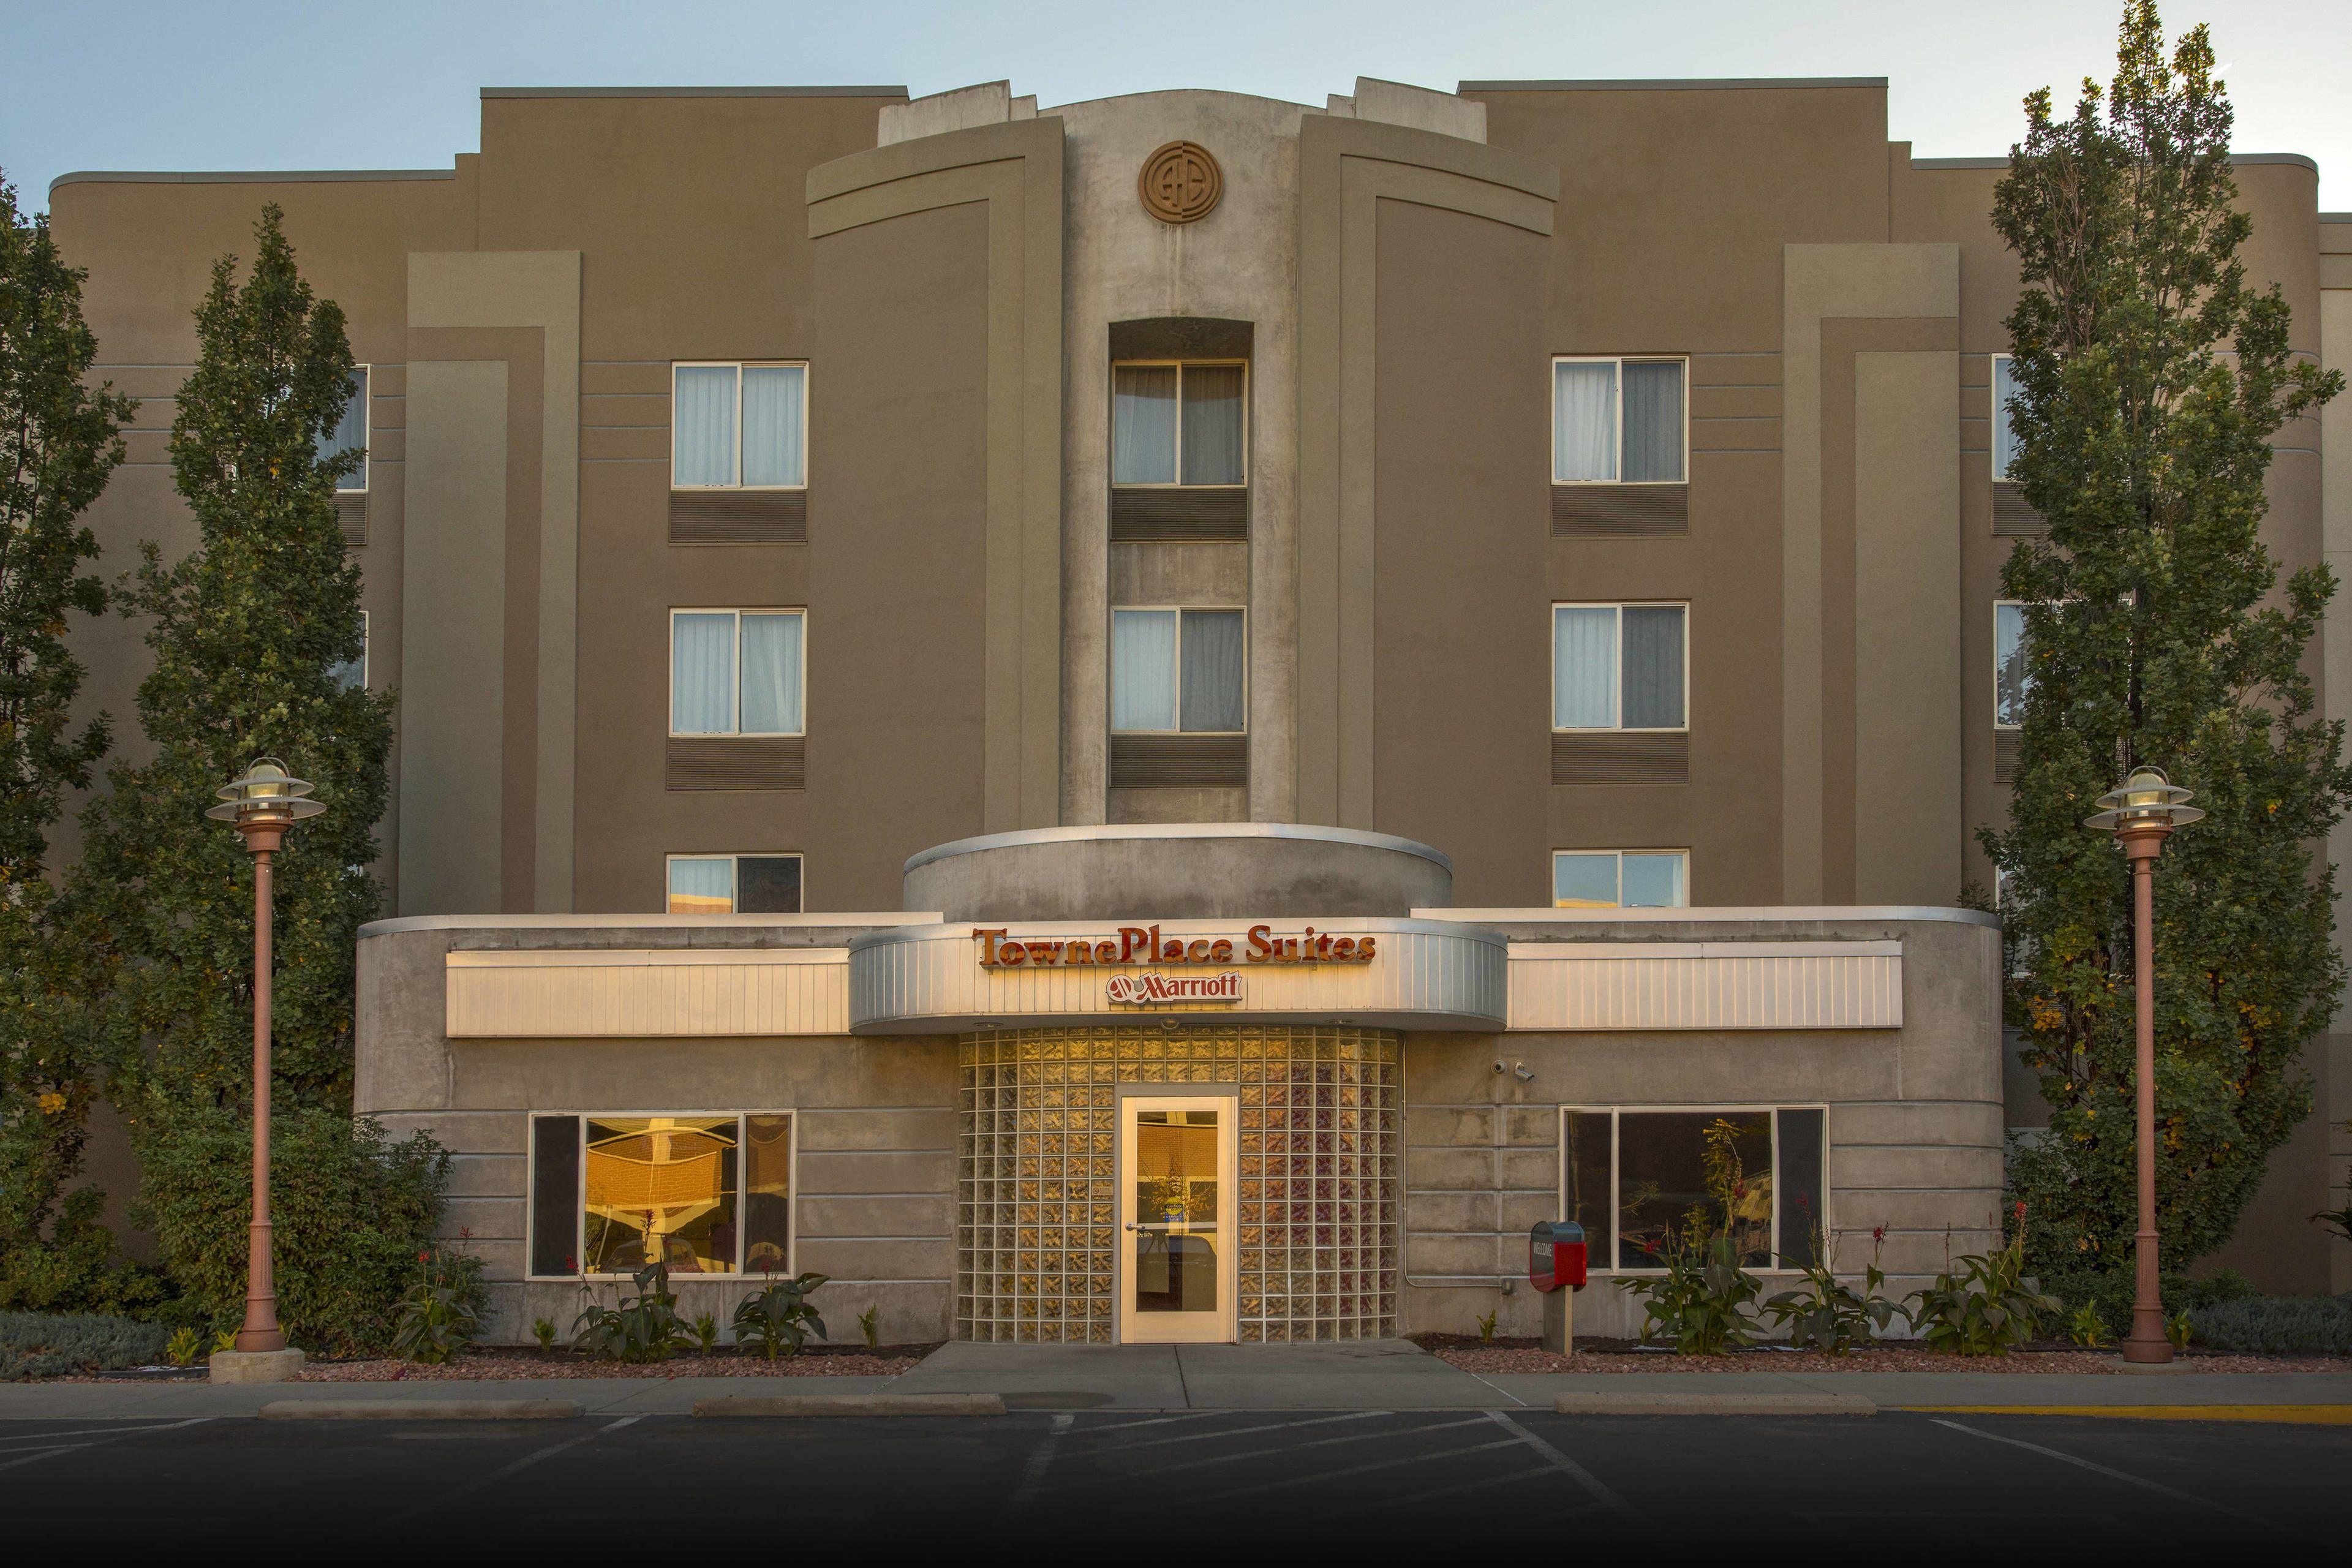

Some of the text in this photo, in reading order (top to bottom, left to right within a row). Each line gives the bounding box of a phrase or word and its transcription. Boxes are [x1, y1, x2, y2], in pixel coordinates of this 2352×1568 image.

[1246, 925, 1376, 963] Suites
[1136, 975, 1237, 1000] Marriott
[1533, 1242, 1552, 1257] WELCOME
